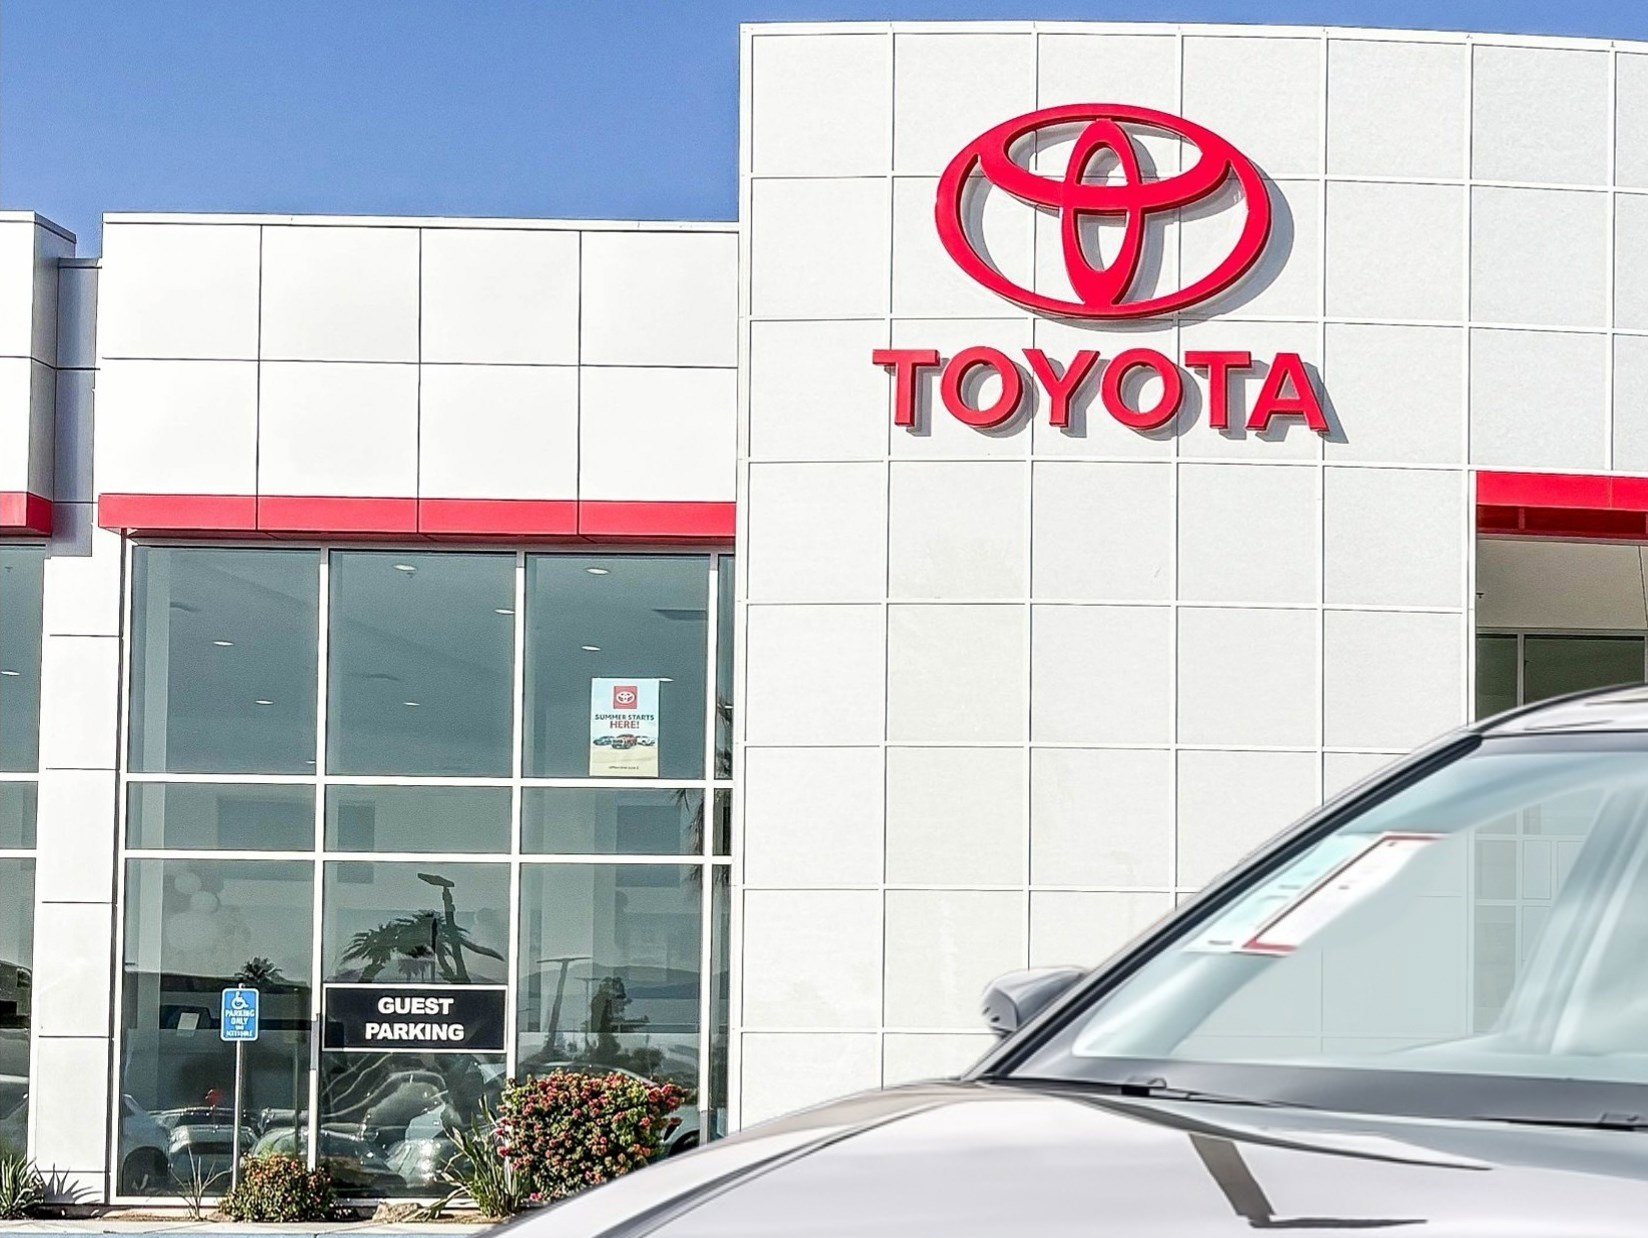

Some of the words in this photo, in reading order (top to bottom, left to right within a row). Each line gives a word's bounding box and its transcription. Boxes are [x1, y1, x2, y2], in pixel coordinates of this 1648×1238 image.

[872, 346, 1330, 432] TOYOTA
[610, 720, 640, 729] HERE!
[377, 997, 454, 1015] GUEST
[364, 1022, 465, 1041] PARKING
